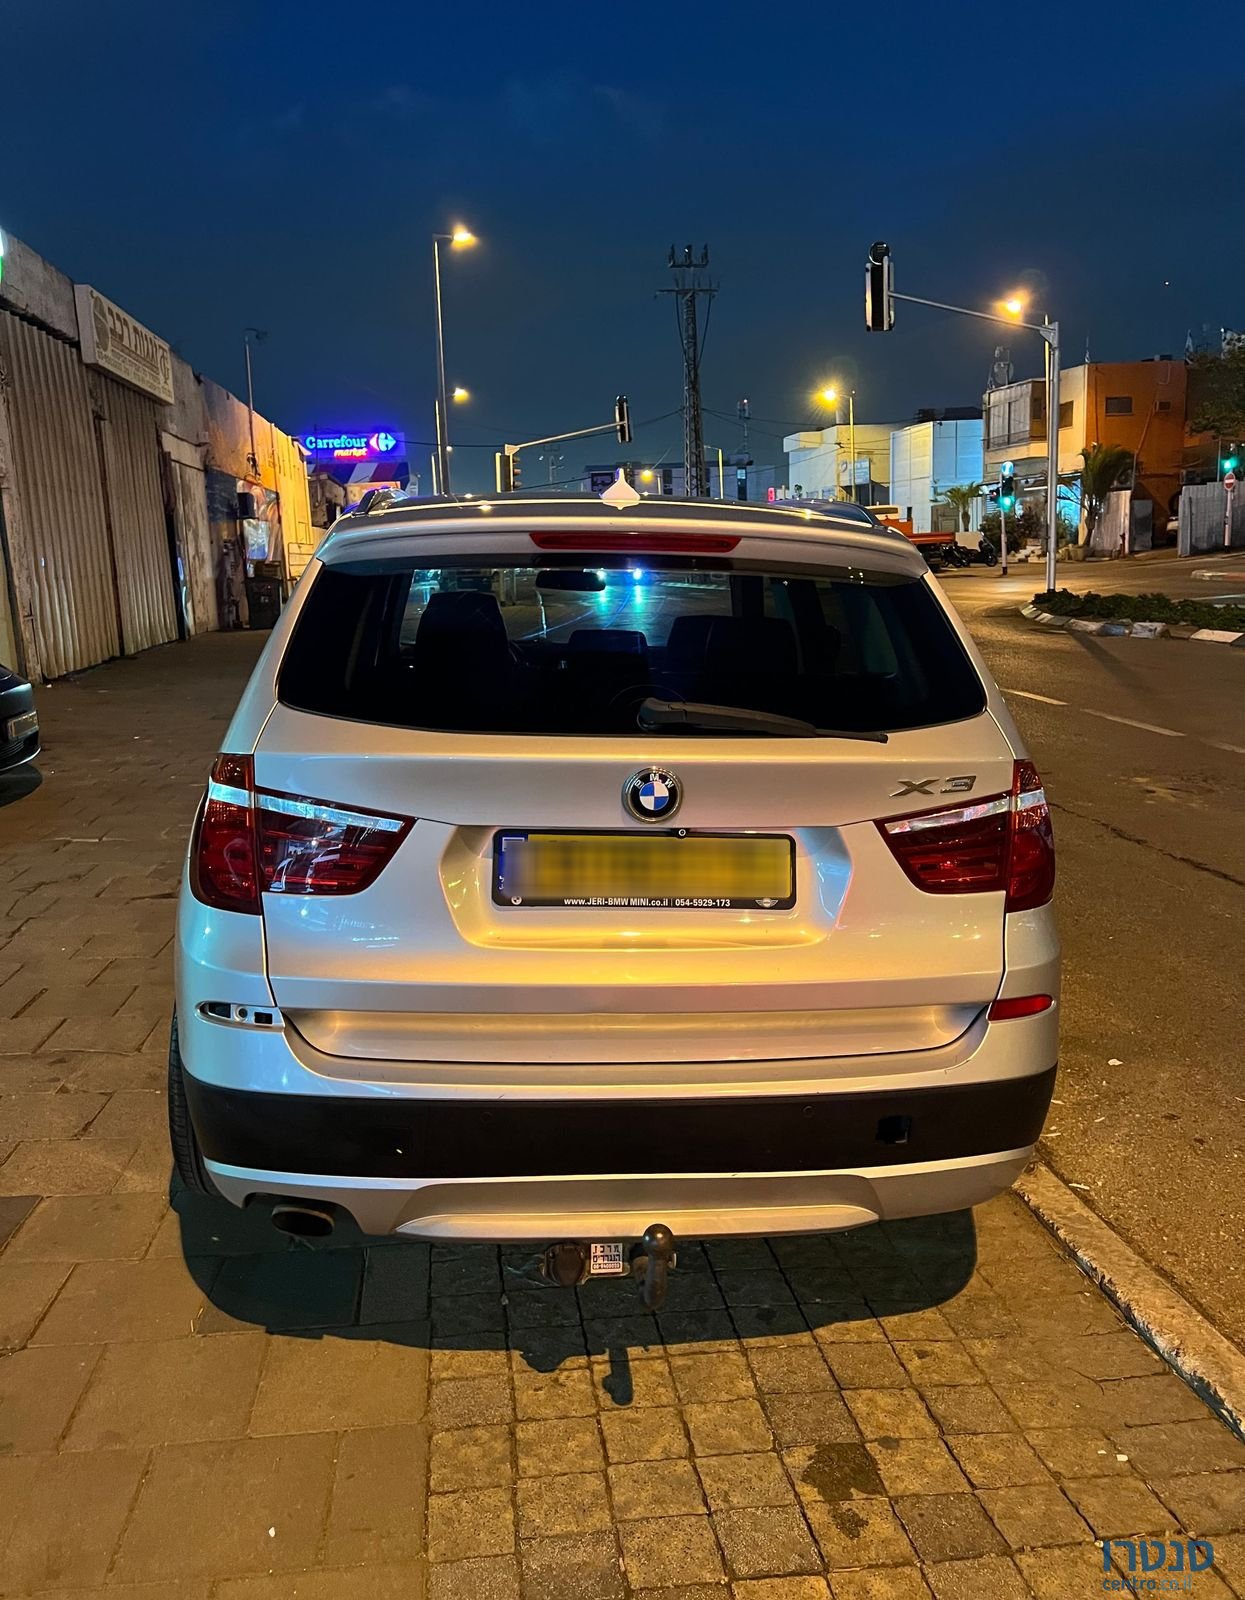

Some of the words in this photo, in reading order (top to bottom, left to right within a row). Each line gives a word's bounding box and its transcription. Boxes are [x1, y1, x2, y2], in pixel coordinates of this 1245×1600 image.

[108, 306, 132, 347] רכב
[305, 435, 367, 449] Carrefour
[334, 448, 368, 457] market
[634, 773, 675, 789] BMW
[888, 775, 977, 798] X3
[675, 898, 731, 908] 054-5929-173
